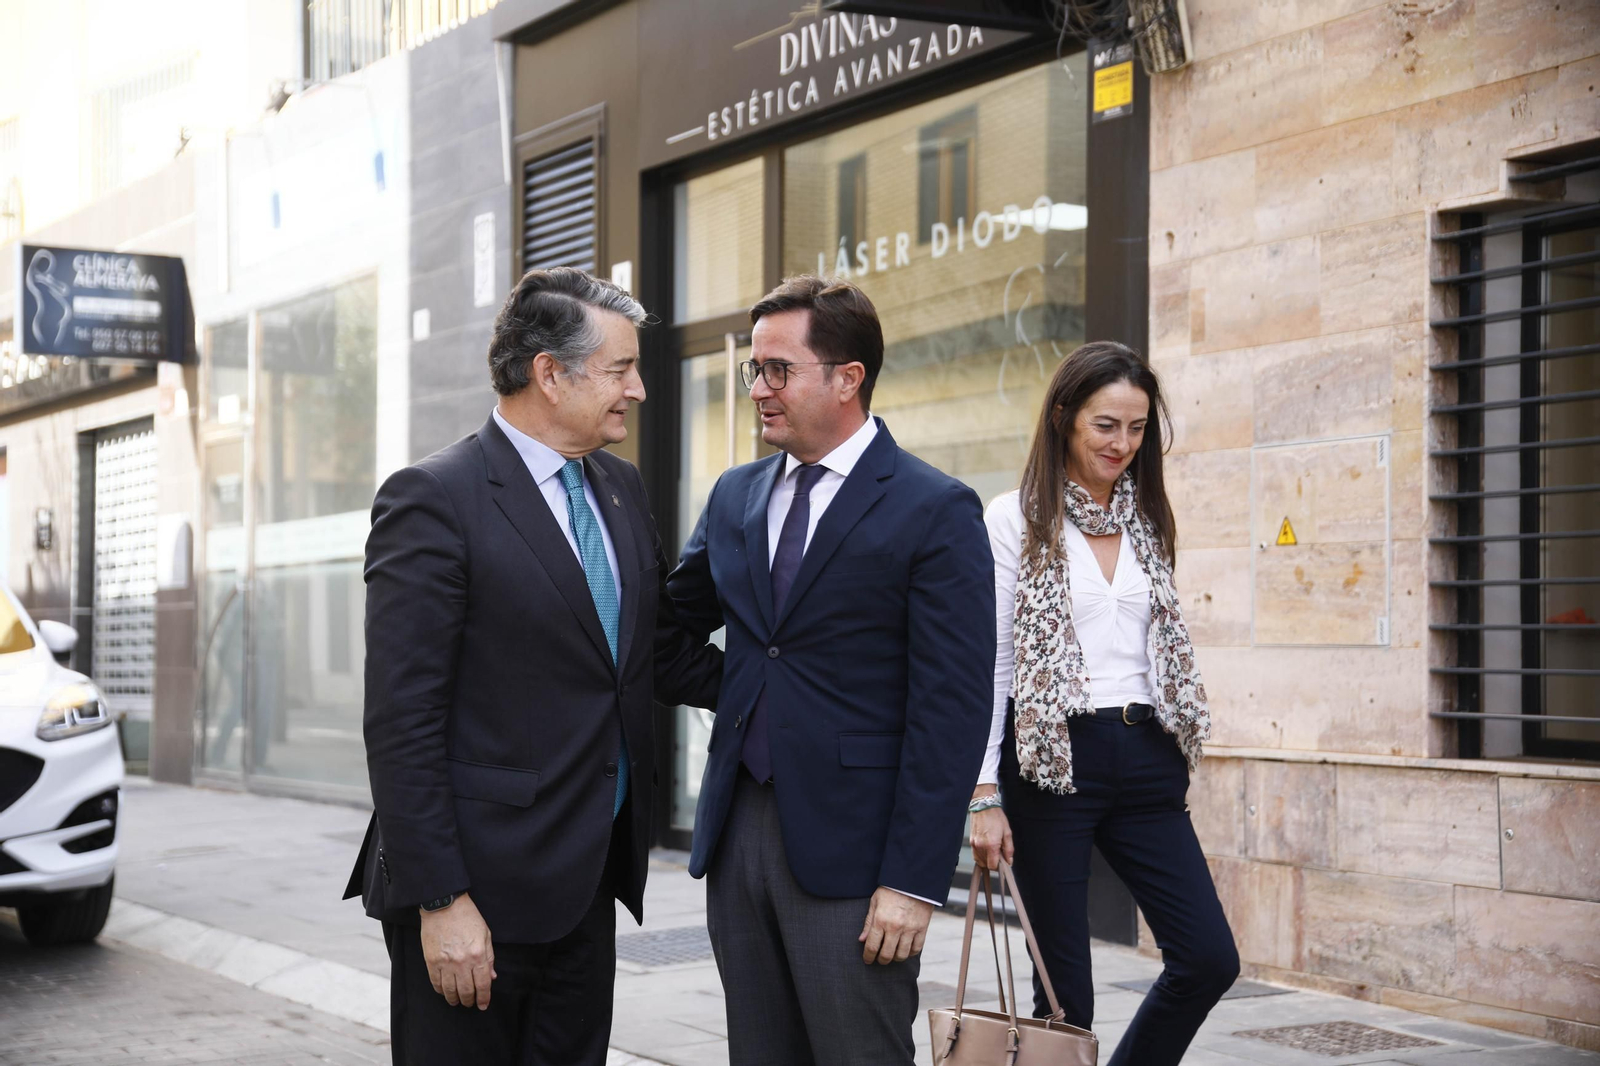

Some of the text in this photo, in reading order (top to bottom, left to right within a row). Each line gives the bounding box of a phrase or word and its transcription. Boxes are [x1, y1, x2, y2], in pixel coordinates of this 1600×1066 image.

[707, 23, 985, 141] ESTÉTICA AVANZADA
[930, 195, 1054, 260] DIODO
